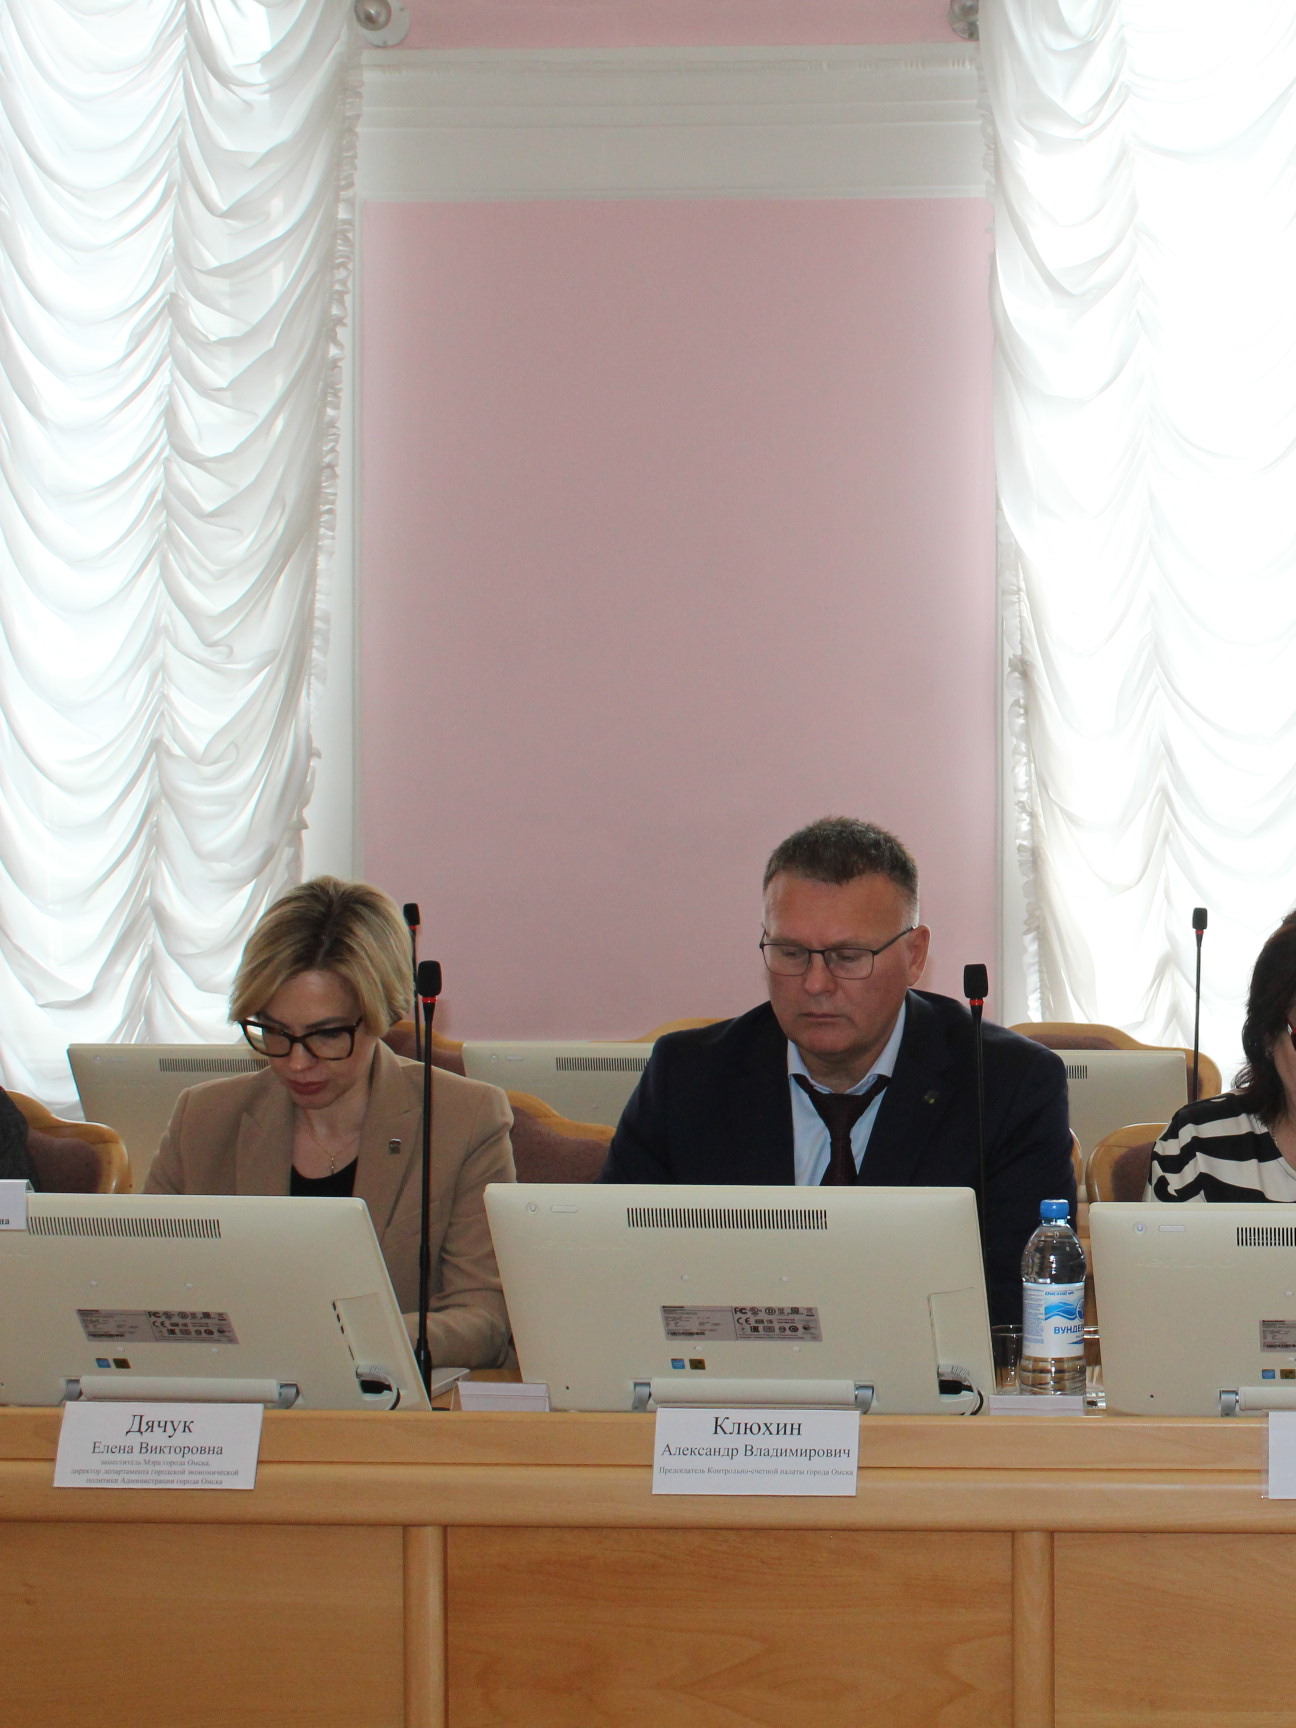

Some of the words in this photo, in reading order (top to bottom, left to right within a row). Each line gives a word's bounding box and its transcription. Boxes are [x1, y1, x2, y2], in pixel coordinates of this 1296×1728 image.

[1054, 1324, 1084, 1334] ВУНДЕ
[126, 1414, 194, 1438] Дячук
[712, 1416, 802, 1436] Клюхин
[91, 1441, 133, 1454] Елена
[139, 1441, 223, 1457] Викторовна
[661, 1444, 739, 1460] Александр
[743, 1444, 850, 1461] Владимирович
[71, 1468, 102, 1476] директор
[151, 1469, 185, 1477] городской
[659, 1466, 705, 1475] Председатель
[806, 1468, 830, 1476] города
[831, 1468, 853, 1476] Омска
[120, 1477, 175, 1485] Администрации
